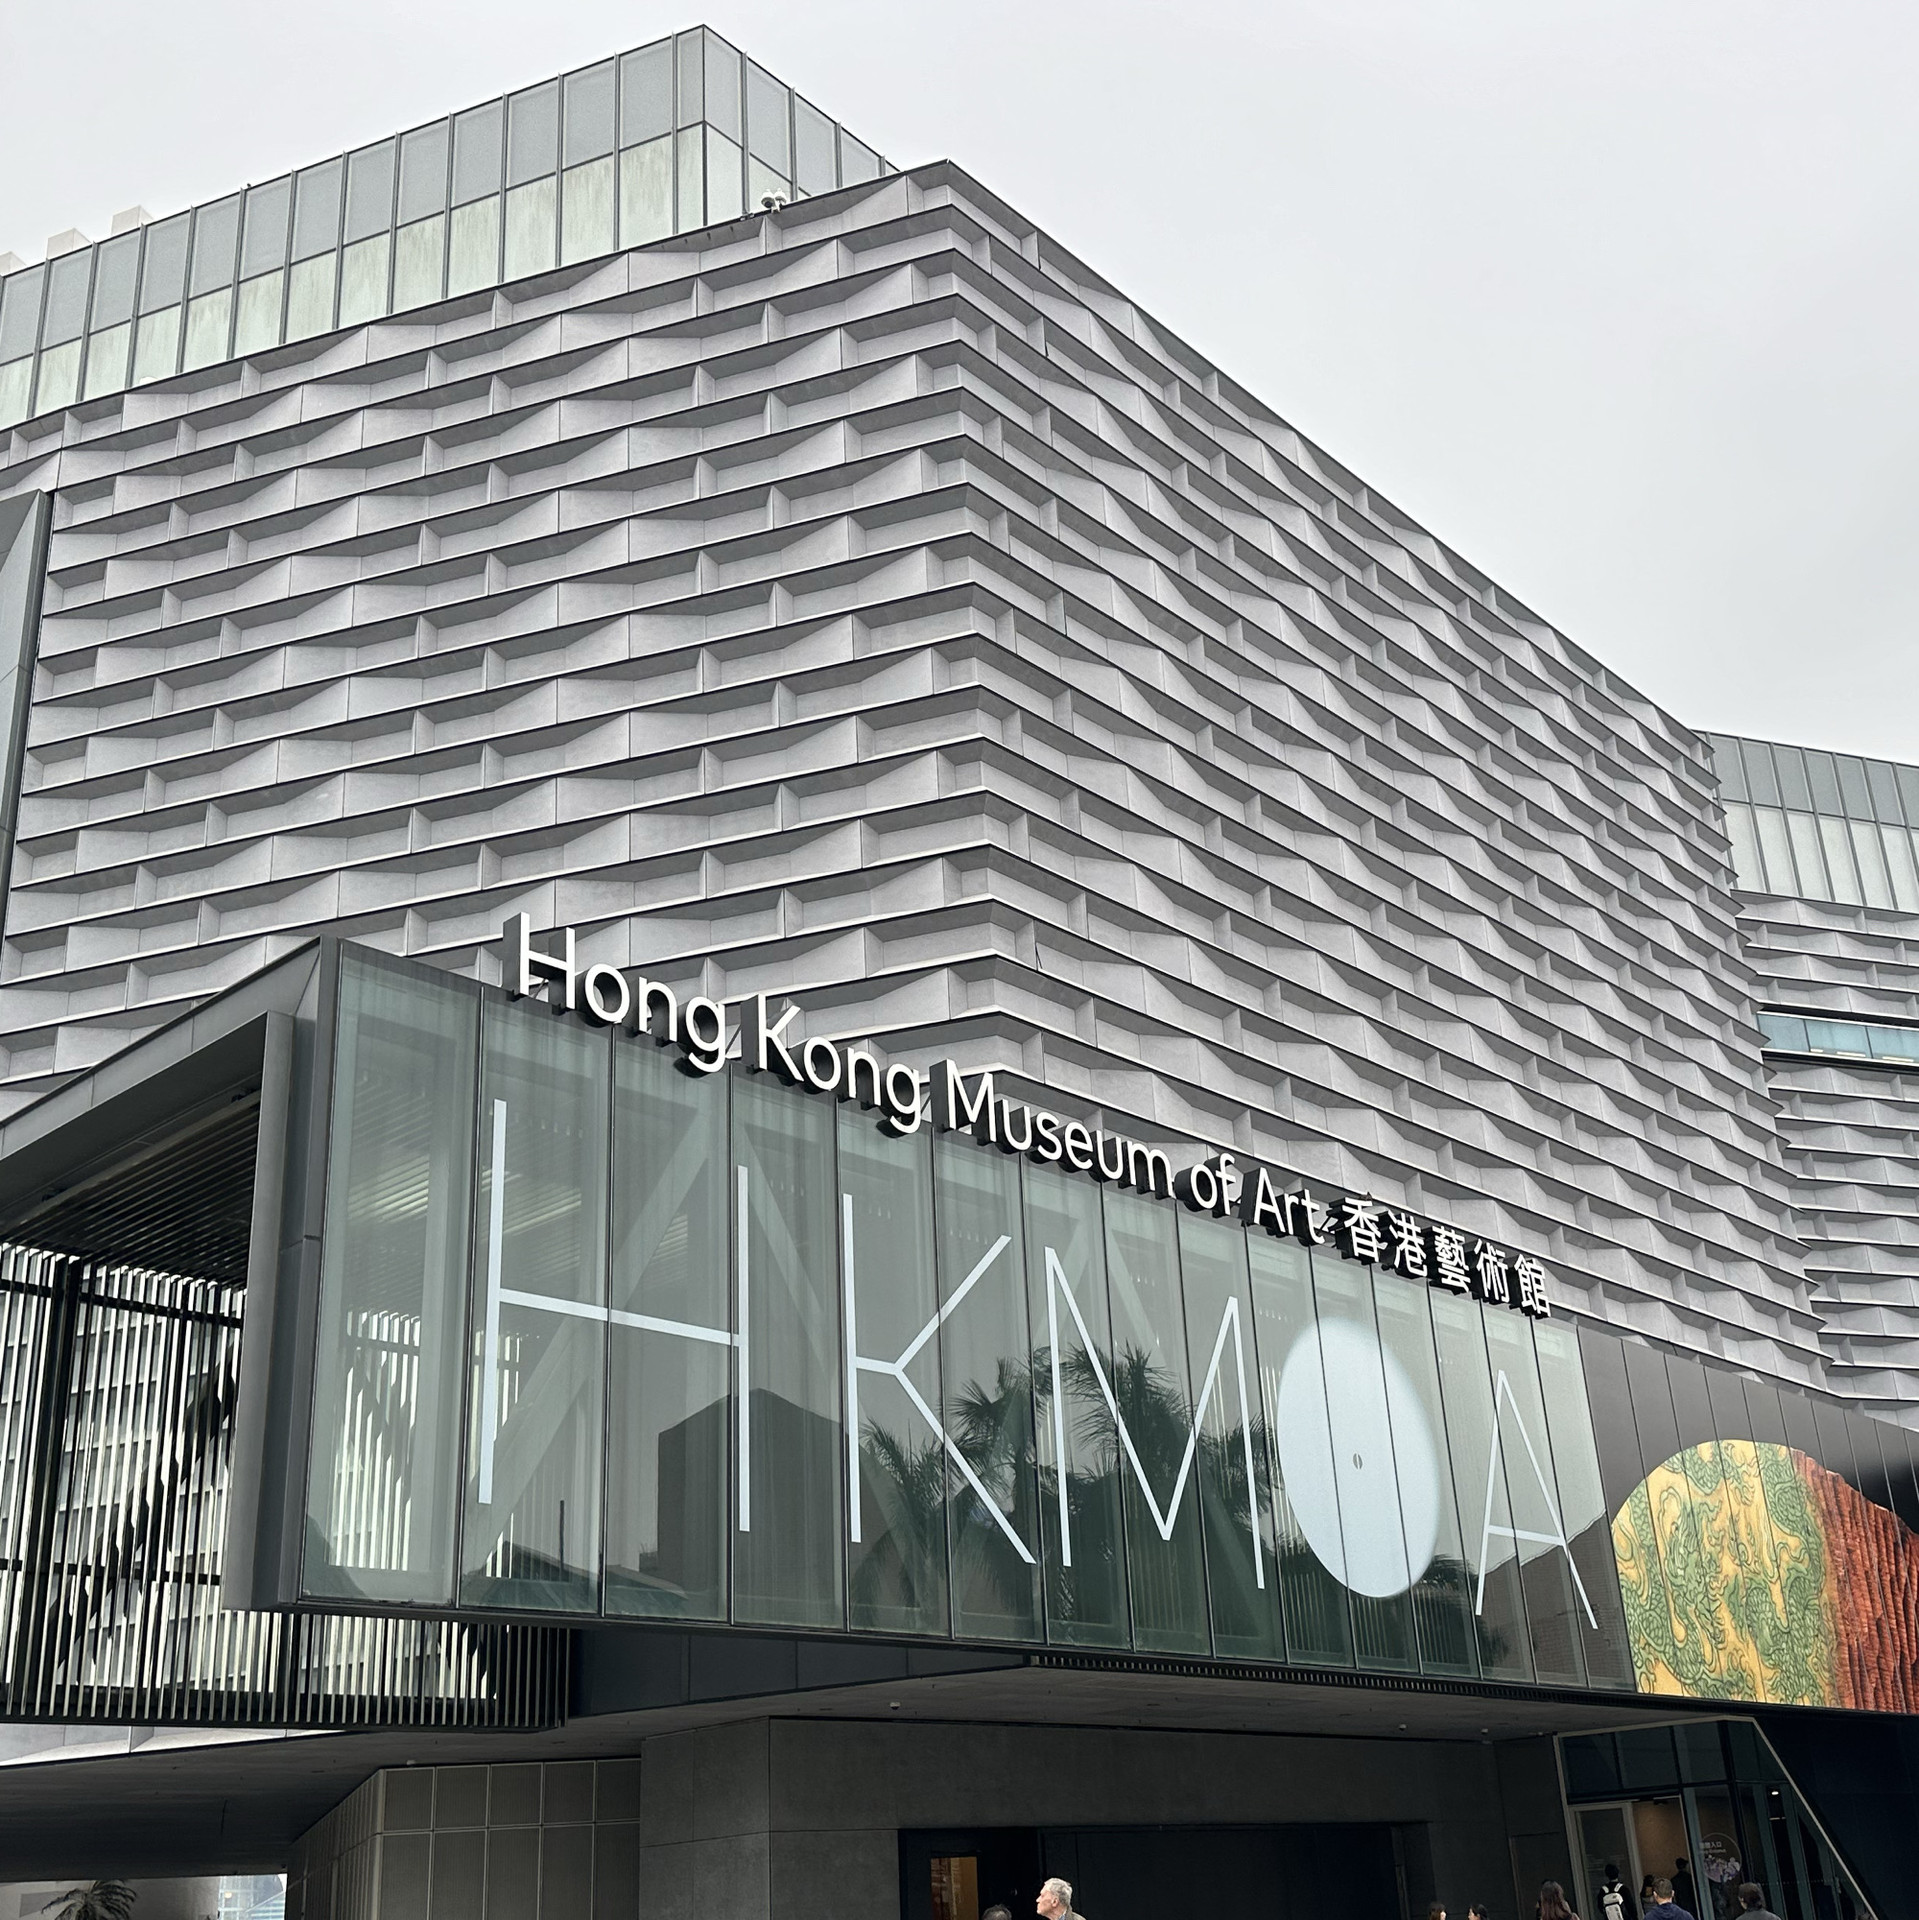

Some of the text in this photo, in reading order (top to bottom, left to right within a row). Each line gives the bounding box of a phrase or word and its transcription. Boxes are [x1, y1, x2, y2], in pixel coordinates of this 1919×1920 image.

[518, 911, 1325, 1244] Hong Kong Museum of Art
[1341, 1197, 1552, 1317] 香港藝術館
